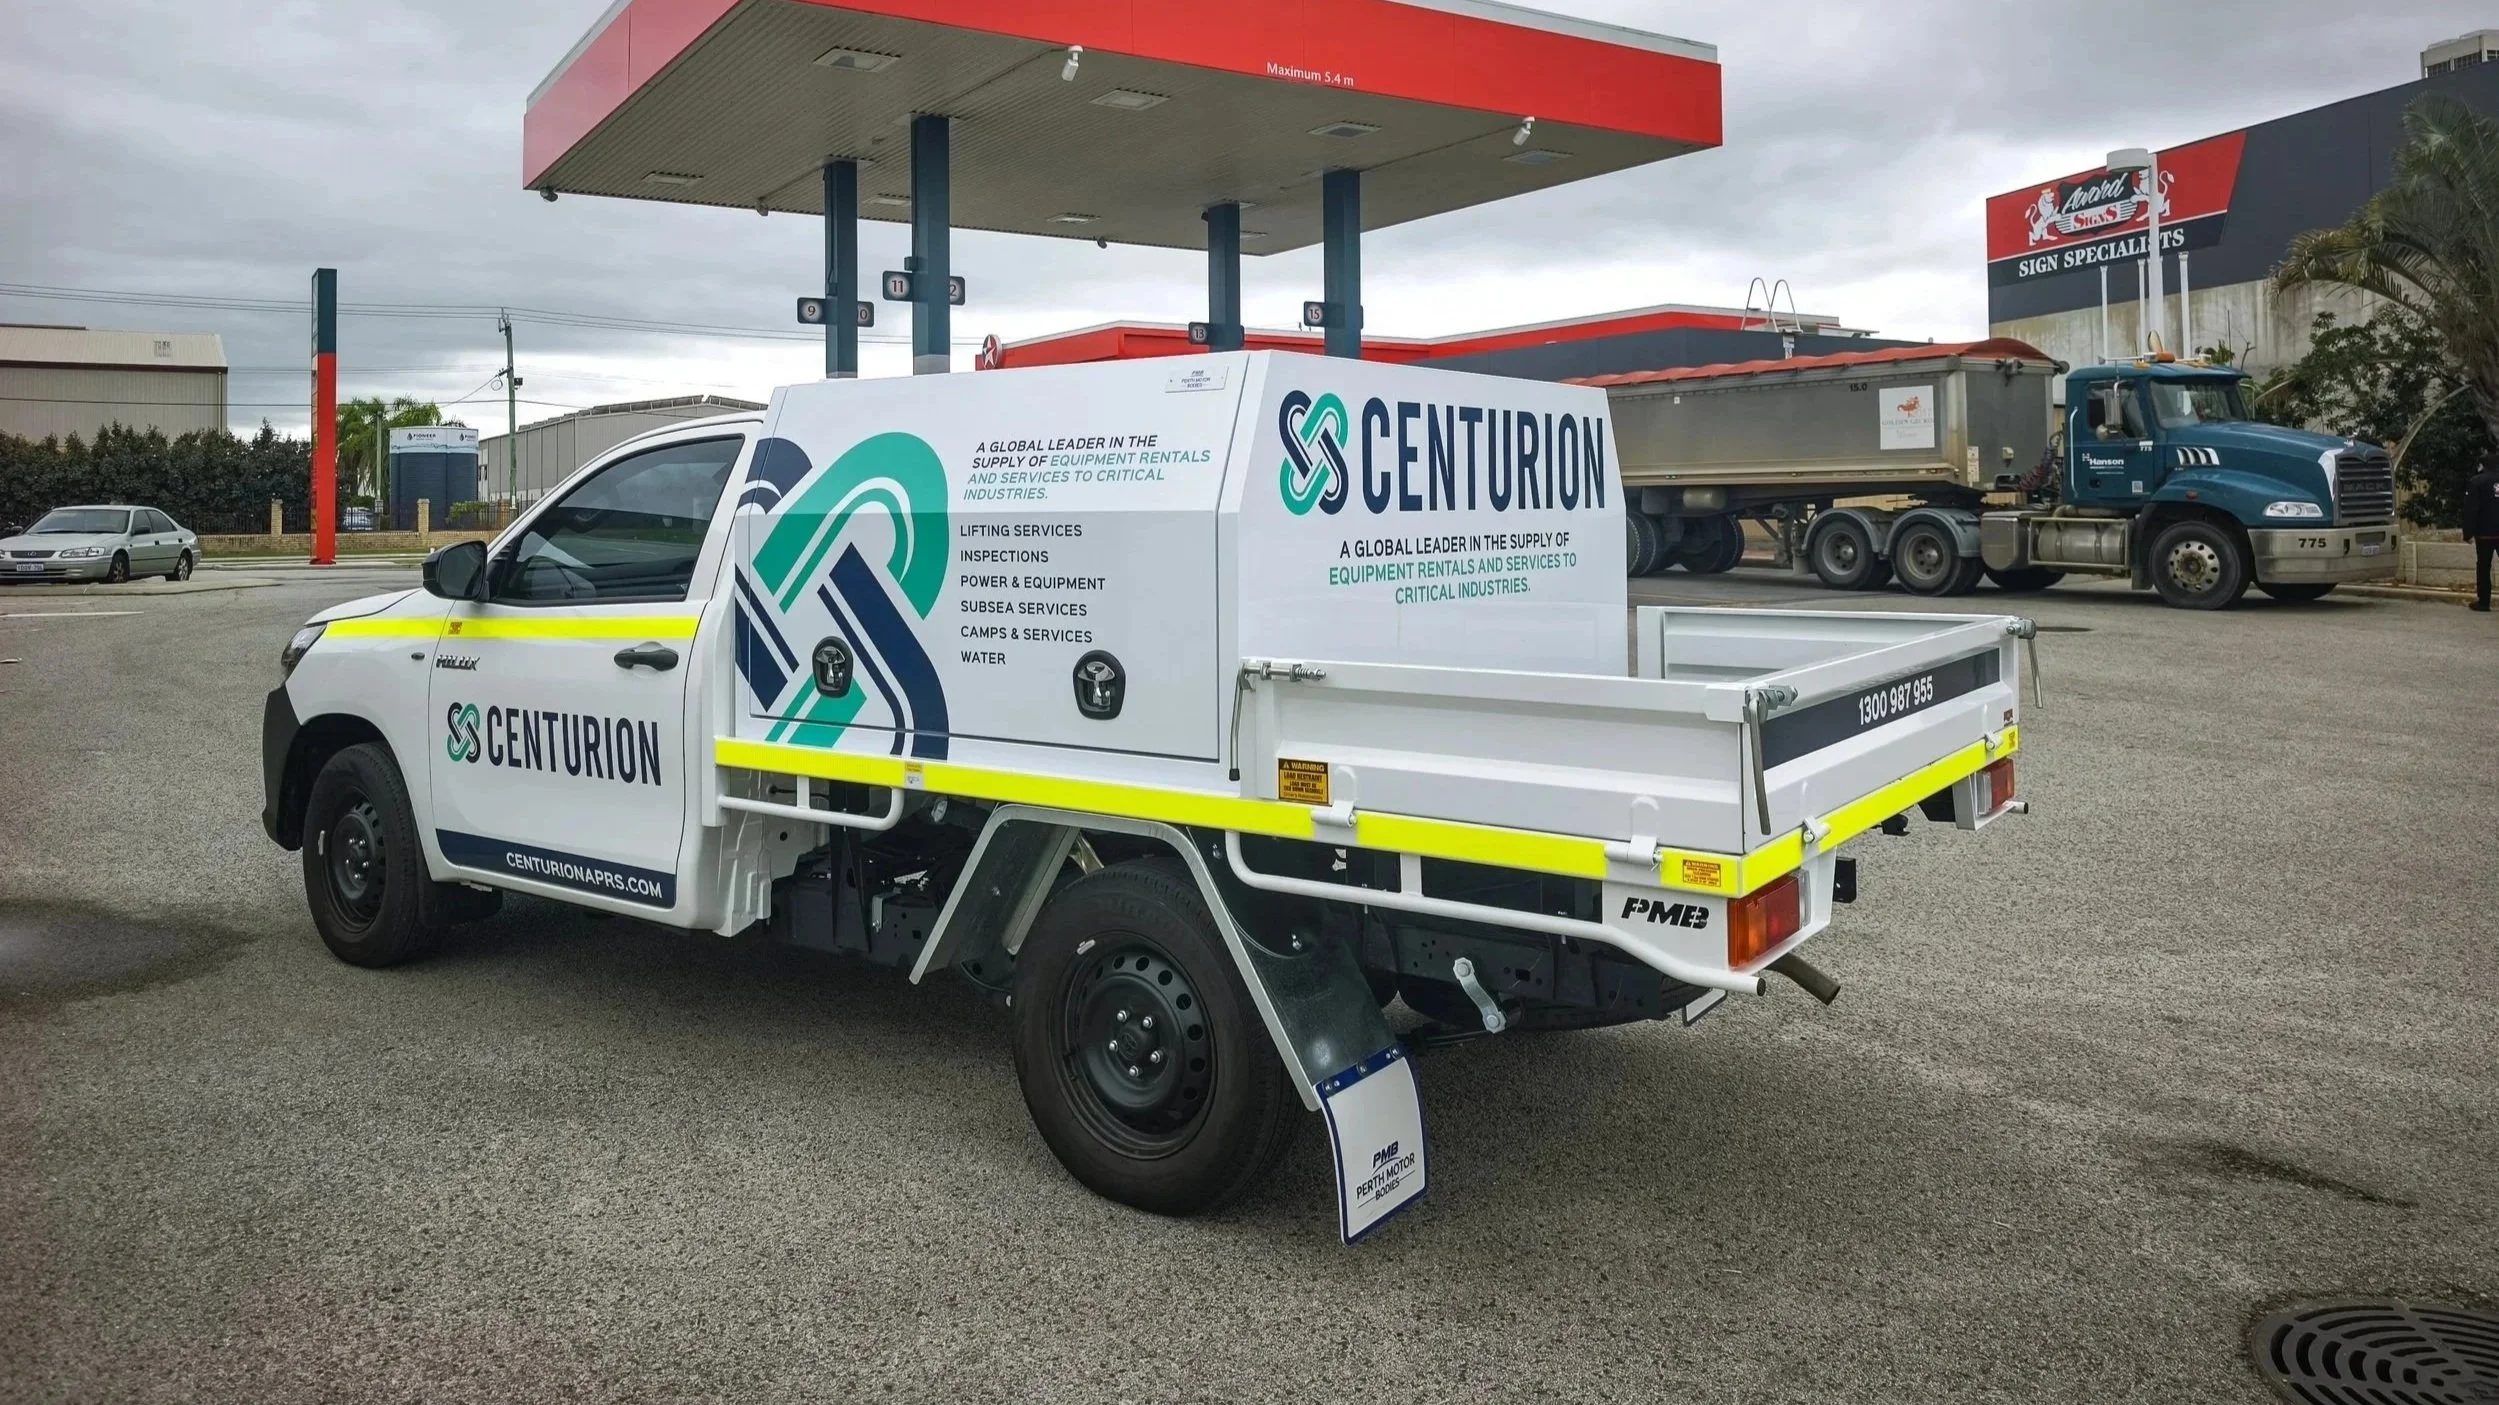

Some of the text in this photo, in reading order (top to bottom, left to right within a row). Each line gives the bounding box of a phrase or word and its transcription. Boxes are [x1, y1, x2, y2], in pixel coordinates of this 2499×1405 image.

[1267, 61, 1354, 86] Maximum 5.4 m
[2062, 172, 2128, 214] Award
[2019, 228, 2185, 278] SIGN SPECIALITS
[892, 280, 904, 293] 11
[950, 284, 957, 297] 2
[808, 305, 816, 316] 9
[860, 309, 868, 320] 0
[1309, 309, 1319, 319] 15
[1195, 328, 1204, 338] 13
[1849, 383, 1868, 392] 15.0
[976, 435, 1158, 453] A GLOBAL LEADER IN THE
[972, 450, 1211, 468] SUPPLY OF EQUIPMENT RENTALS
[1361, 397, 1605, 514] CENTURION
[967, 468, 1164, 485] AND SERVICES TO CRITICAL
[964, 488, 1048, 500] INDUSTRIES.
[961, 524, 1083, 537] LIFTING SERVICES
[1340, 531, 1570, 559] A GLOBAL LEADER IN THE SUPPLY OF
[2298, 538, 2327, 548] 775
[961, 550, 1049, 563] INSPECTIONS
[1329, 552, 1577, 586] EQUIPMENT RENTALS AND SERVICES TO
[961, 575, 1106, 590] POWER & EQUIPMENT
[1395, 577, 1531, 605] CRITICAL INDUSTRIES.
[961, 600, 1087, 616] SUBSEA SERVICES
[961, 626, 1093, 643] CAMPS & SERVICES
[436, 654, 480, 671] HILUX
[961, 650, 1006, 665] WATER
[1859, 675, 1933, 725] 1300 987 955
[486, 705, 662, 786] CENTURION
[1291, 762, 1324, 772] WARNING
[506, 852, 662, 898] CENTURIONAPRS.COM
[1621, 897, 1710, 930] PMB
[1373, 1141, 1399, 1168] PMB
[1356, 1152, 1415, 1199] PERTH MOTOR
[1376, 1177, 1400, 1201] BODIES
